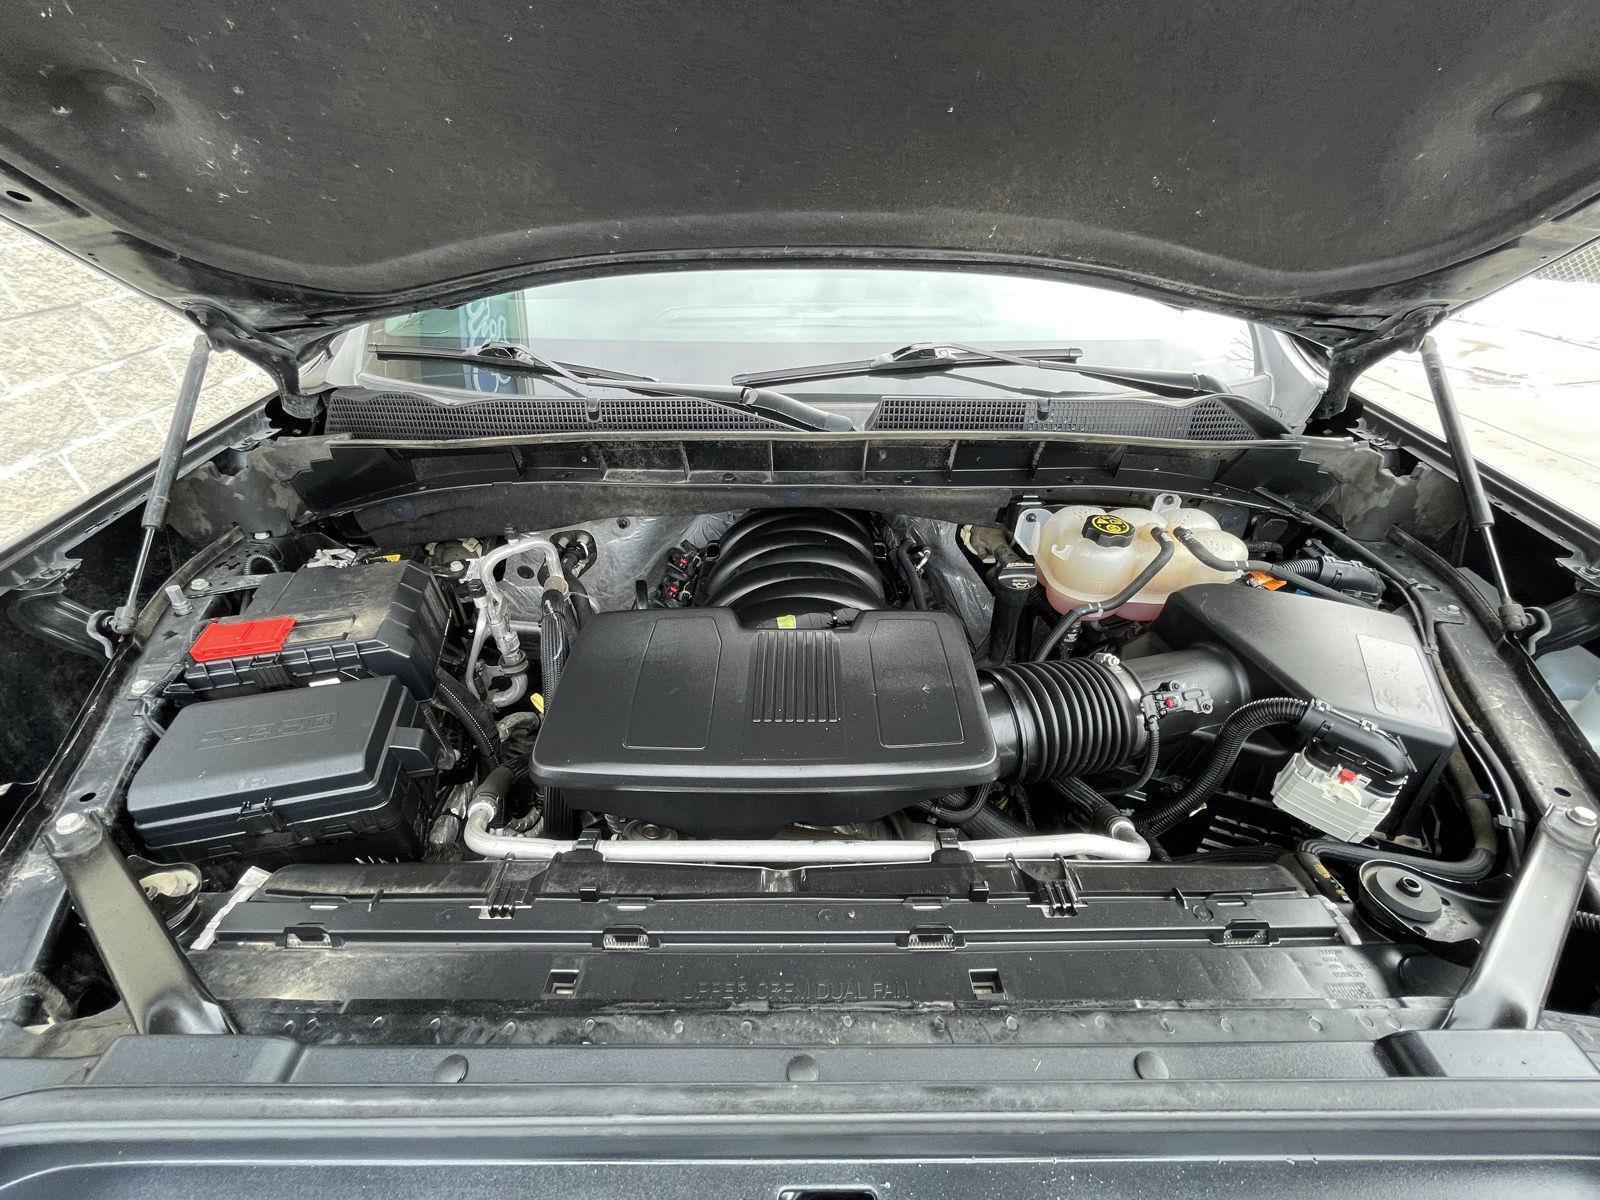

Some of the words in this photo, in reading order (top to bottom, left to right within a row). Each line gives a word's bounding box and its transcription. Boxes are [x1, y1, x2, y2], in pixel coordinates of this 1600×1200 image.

[683, 982, 749, 1000] UPPER
[816, 981, 868, 1000] DUAL
[872, 981, 911, 999] FAN
